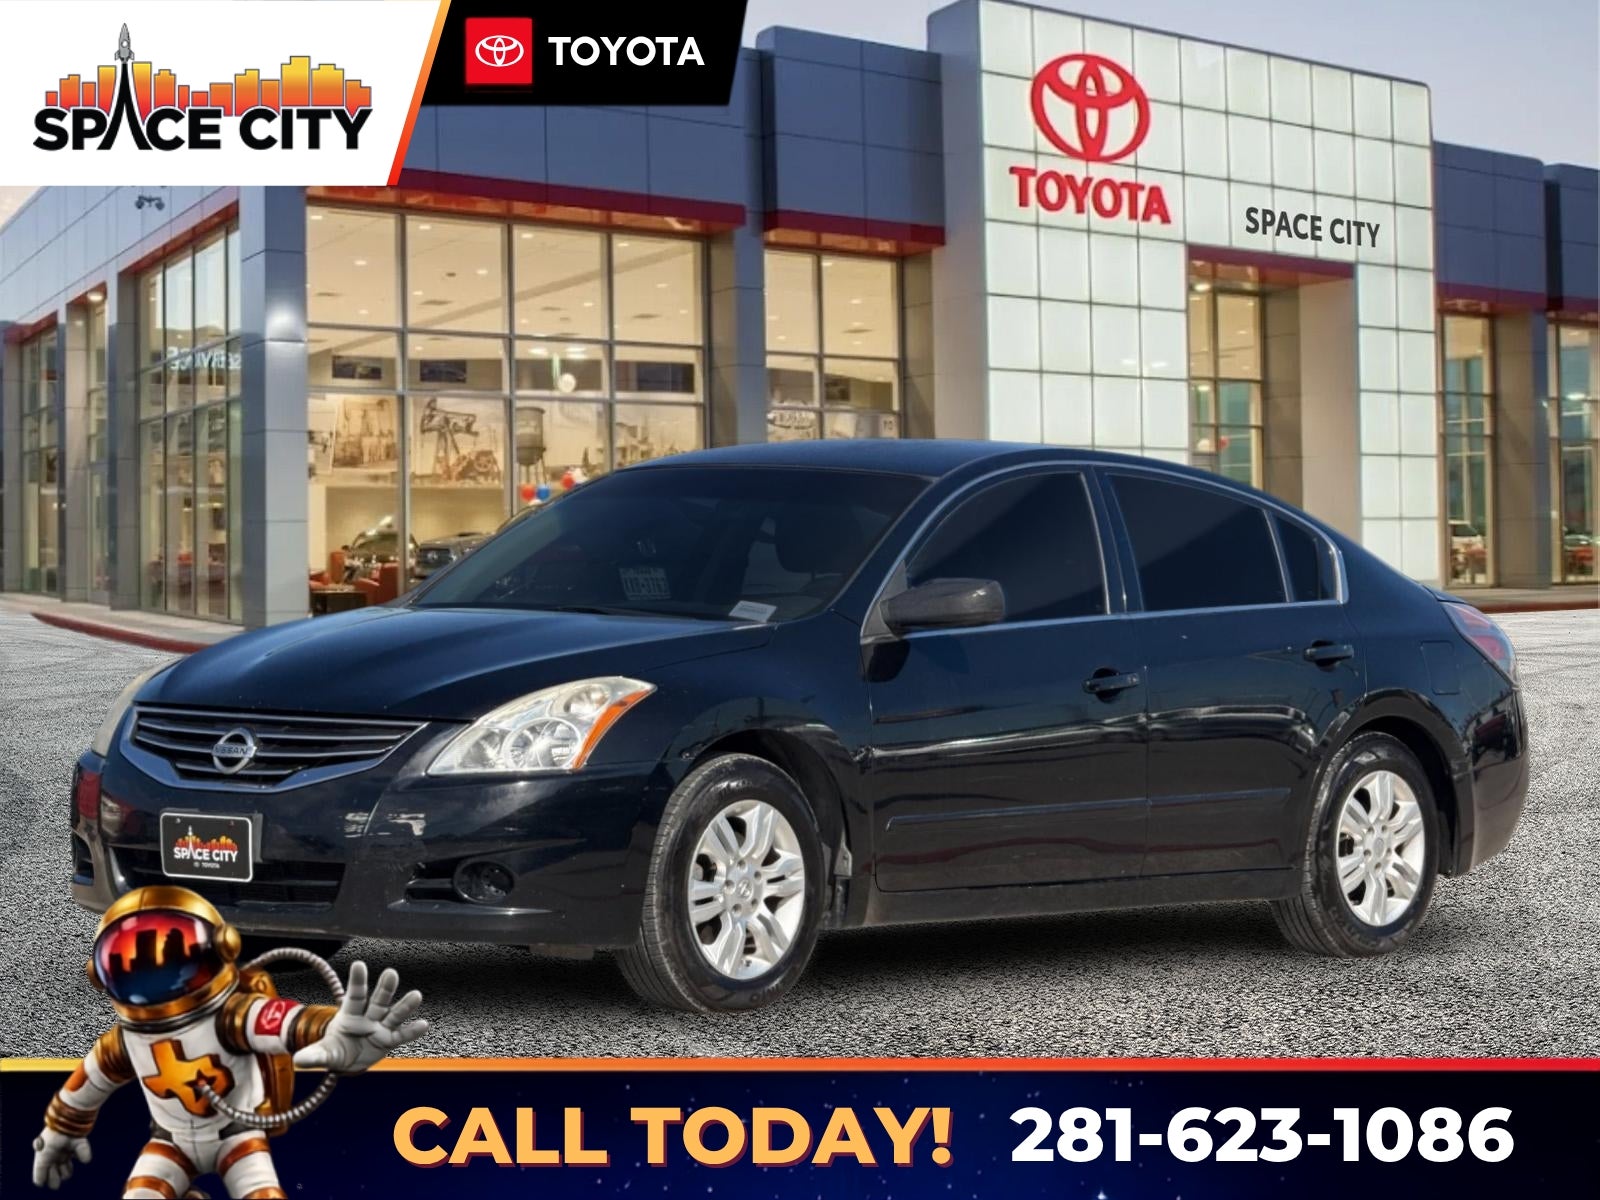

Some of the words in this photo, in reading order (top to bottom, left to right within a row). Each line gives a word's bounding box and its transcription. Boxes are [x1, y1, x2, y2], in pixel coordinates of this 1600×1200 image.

[1009, 165, 1171, 224] TOYOTA
[1245, 206, 1323, 242] SPACE
[1329, 217, 1381, 248] CITY
[174, 847, 210, 861] SPACE
[212, 849, 238, 862] CITY
